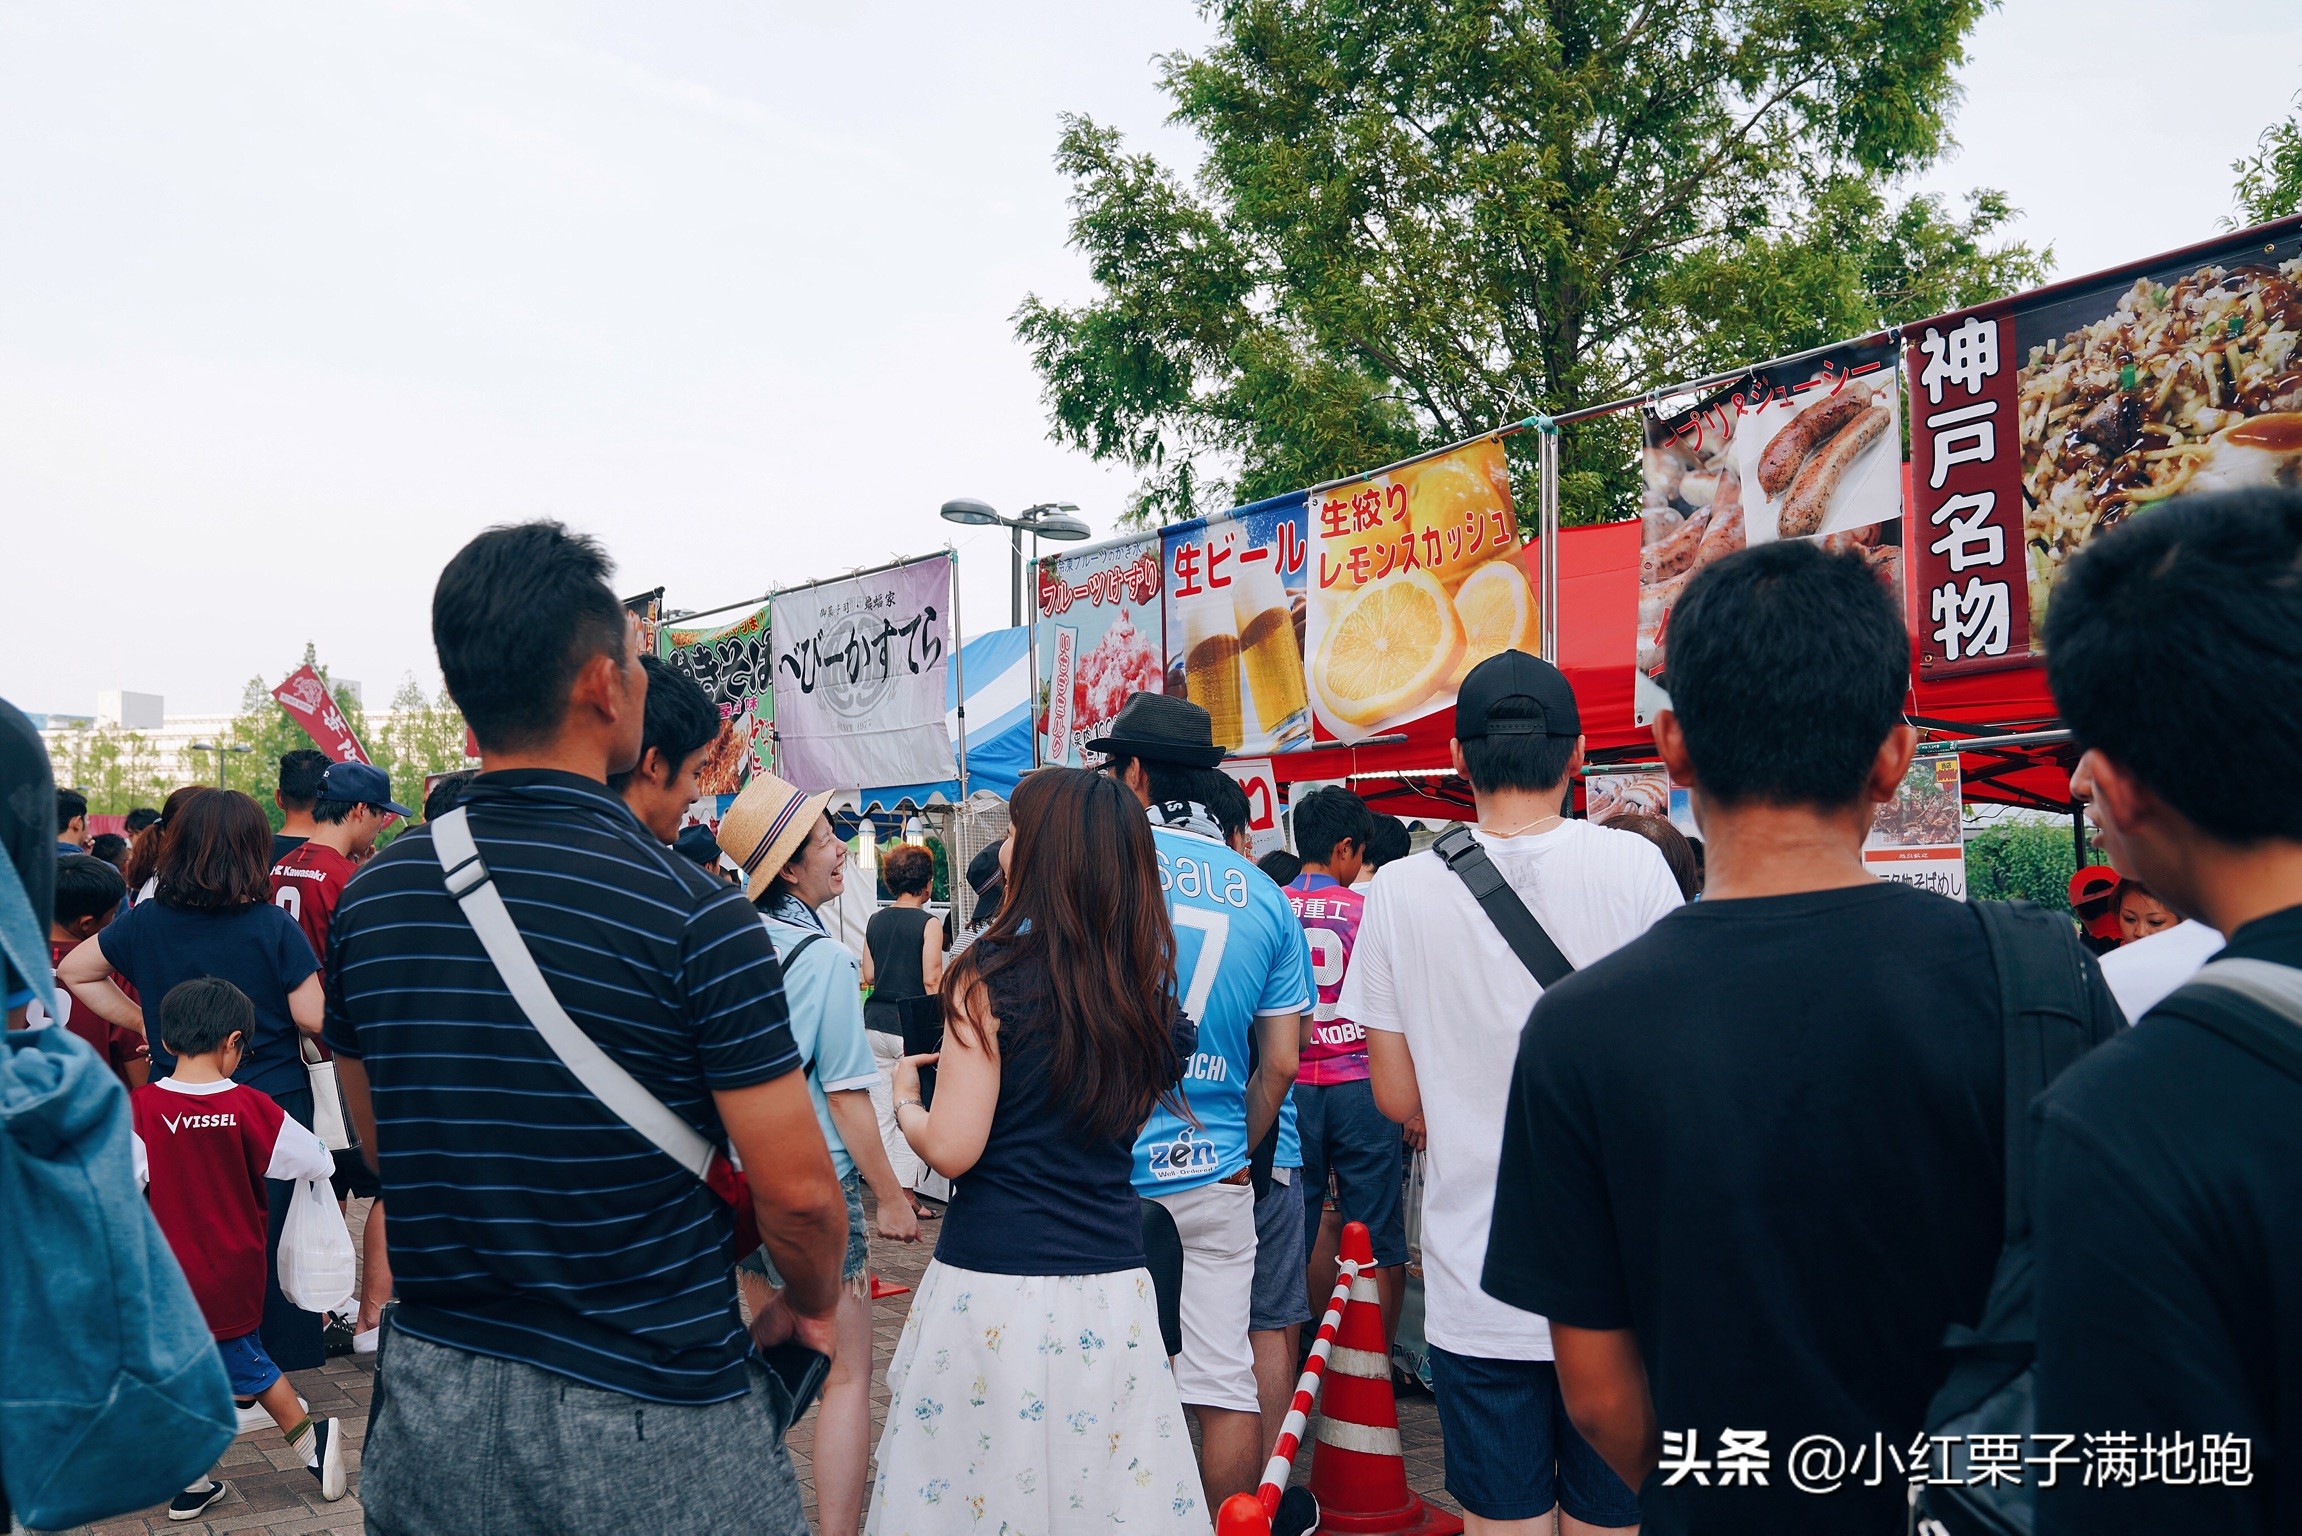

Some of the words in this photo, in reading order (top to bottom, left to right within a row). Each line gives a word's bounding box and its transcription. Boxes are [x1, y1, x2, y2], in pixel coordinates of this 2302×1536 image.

[1319, 483, 1408, 540] 生絞り
[1919, 316, 2012, 662] 神戸名物
[1174, 521, 1307, 599] 生ビール
[1318, 510, 1512, 590] レモンスカッシュ
[1041, 558, 1159, 618] フルーツけずり
[778, 605, 942, 695] べびーかすてら
[283, 866, 327, 883] Kawasaki
[182, 1113, 237, 1129] VISSEL
[1150, 1143, 1216, 1170] zen
